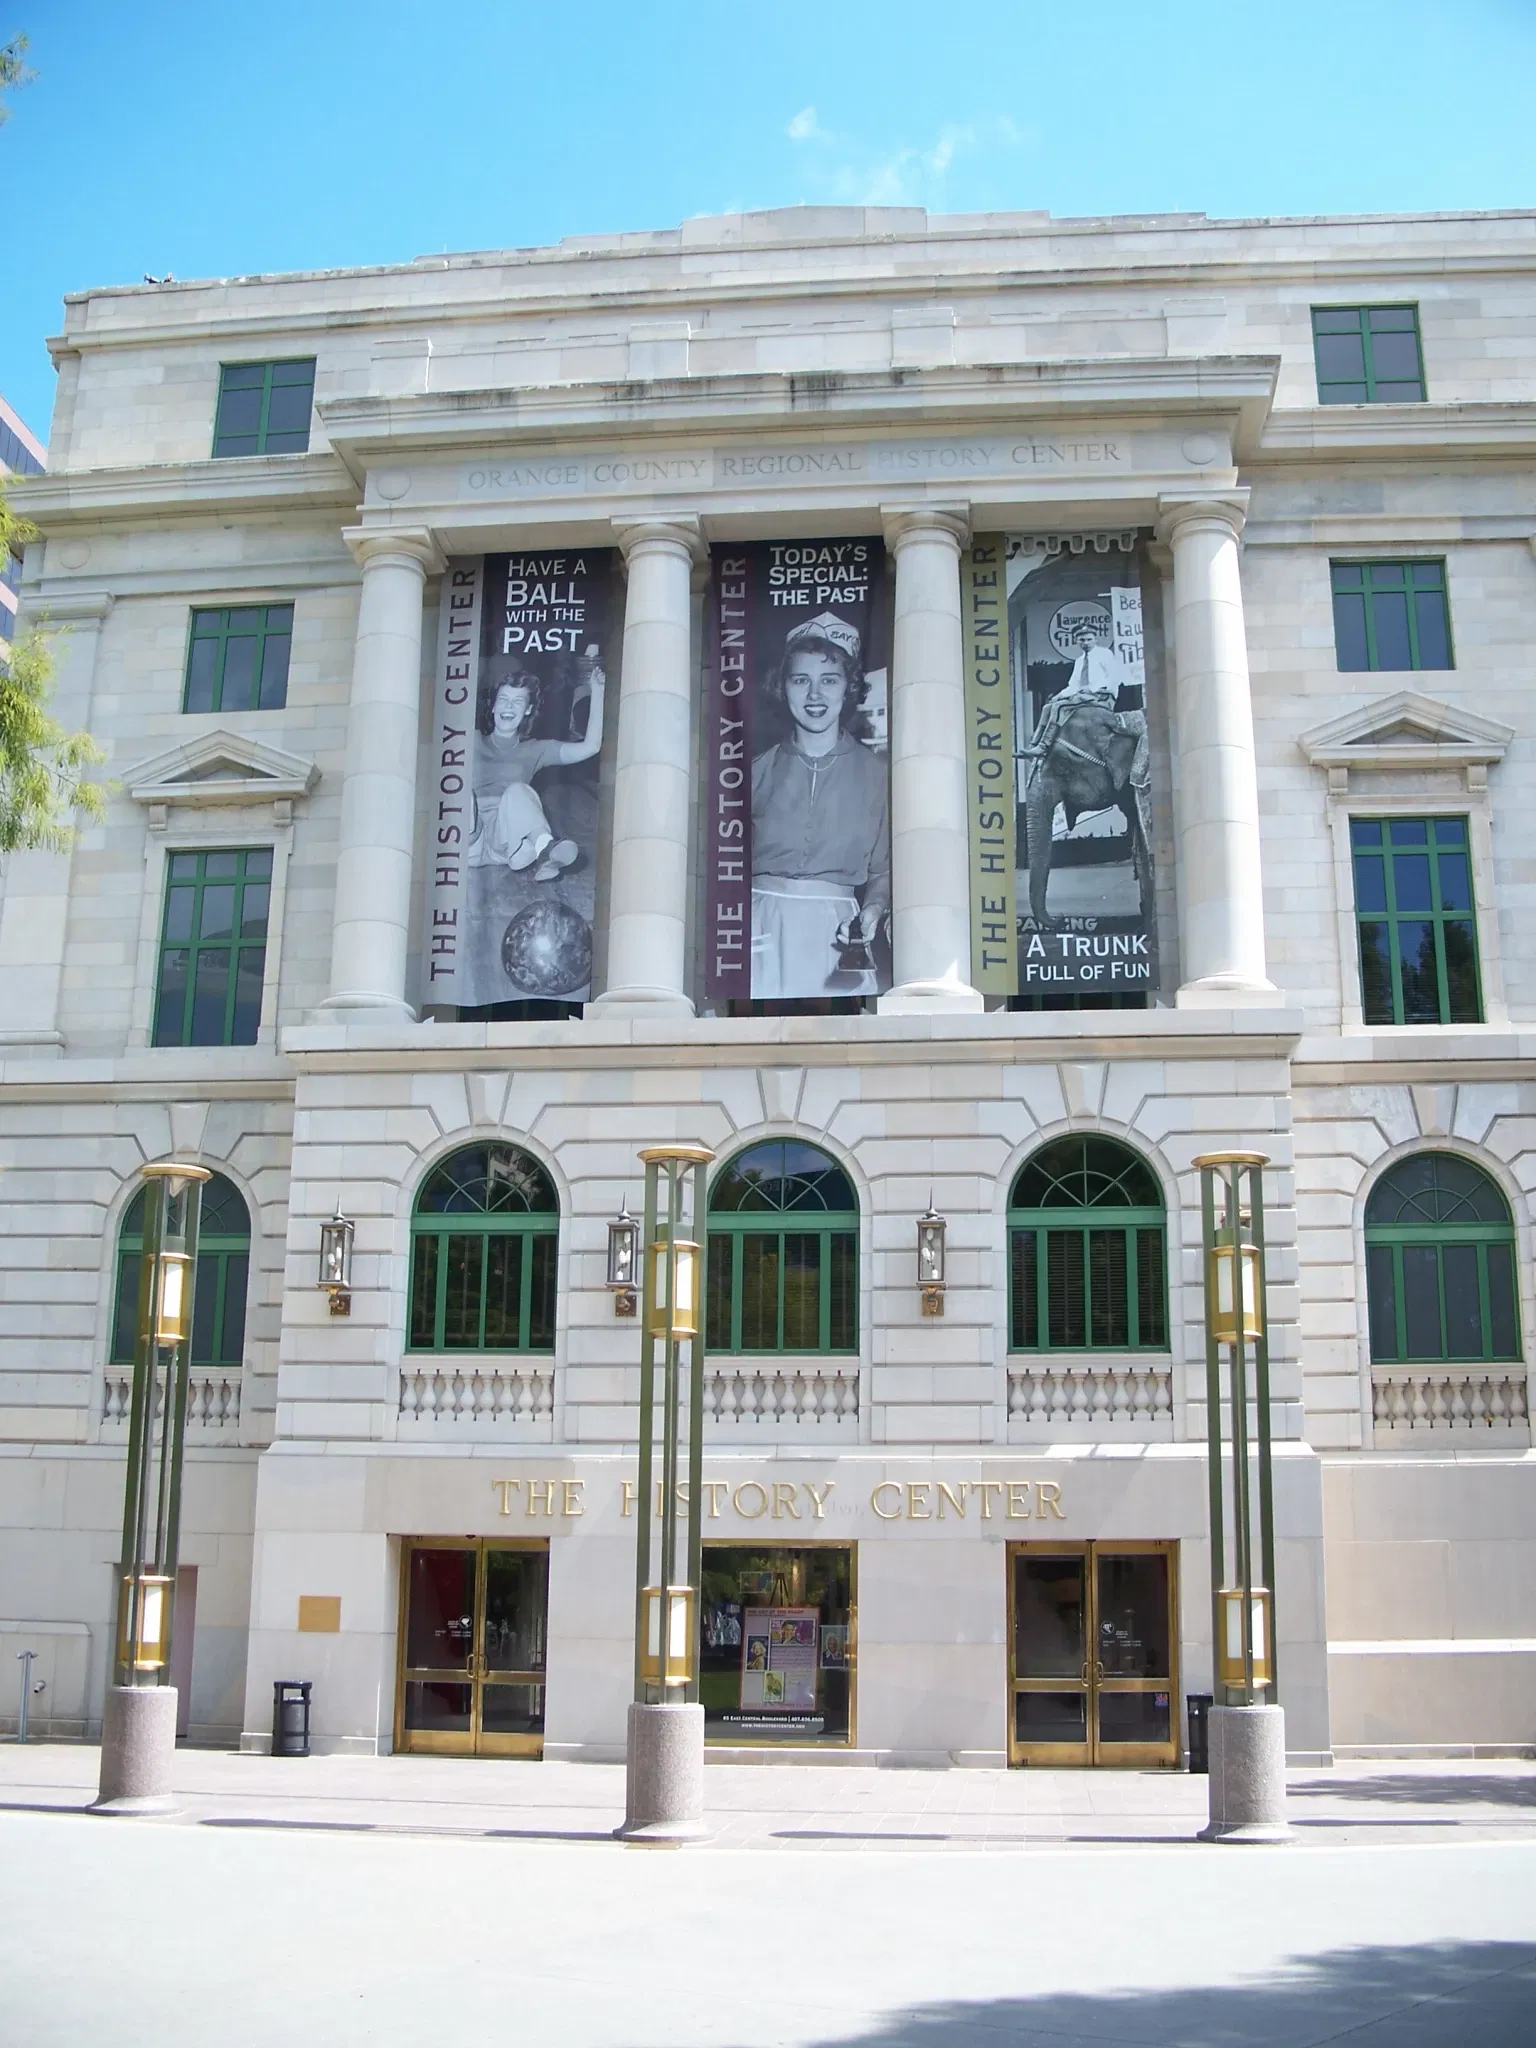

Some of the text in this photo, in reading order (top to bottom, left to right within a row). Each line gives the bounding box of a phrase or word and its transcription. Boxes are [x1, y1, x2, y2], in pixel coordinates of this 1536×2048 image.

[468, 443, 1121, 489] ORANGE COUNTY REGIONAL HISTORY CENTER
[769, 543, 868, 566] TODAY'S
[508, 558, 587, 577] HAVE A
[768, 565, 868, 586] SPECIAL:
[506, 580, 586, 607] BALL
[769, 585, 868, 607] THE PAST
[506, 607, 585, 624] WITH THE
[1056, 613, 1112, 630] Lawrence
[502, 626, 583, 654] PAST
[716, 558, 746, 977] THE HISTORY CENTER
[972, 547, 1008, 970] THE HISTORY CENTER
[430, 568, 476, 981] THE HISTORY CENTER
[1026, 933, 1149, 958] A TRUNK
[1026, 961, 1150, 982] FULL OF FUN
[491, 1479, 1068, 1519] THE HISTORY CENTER
